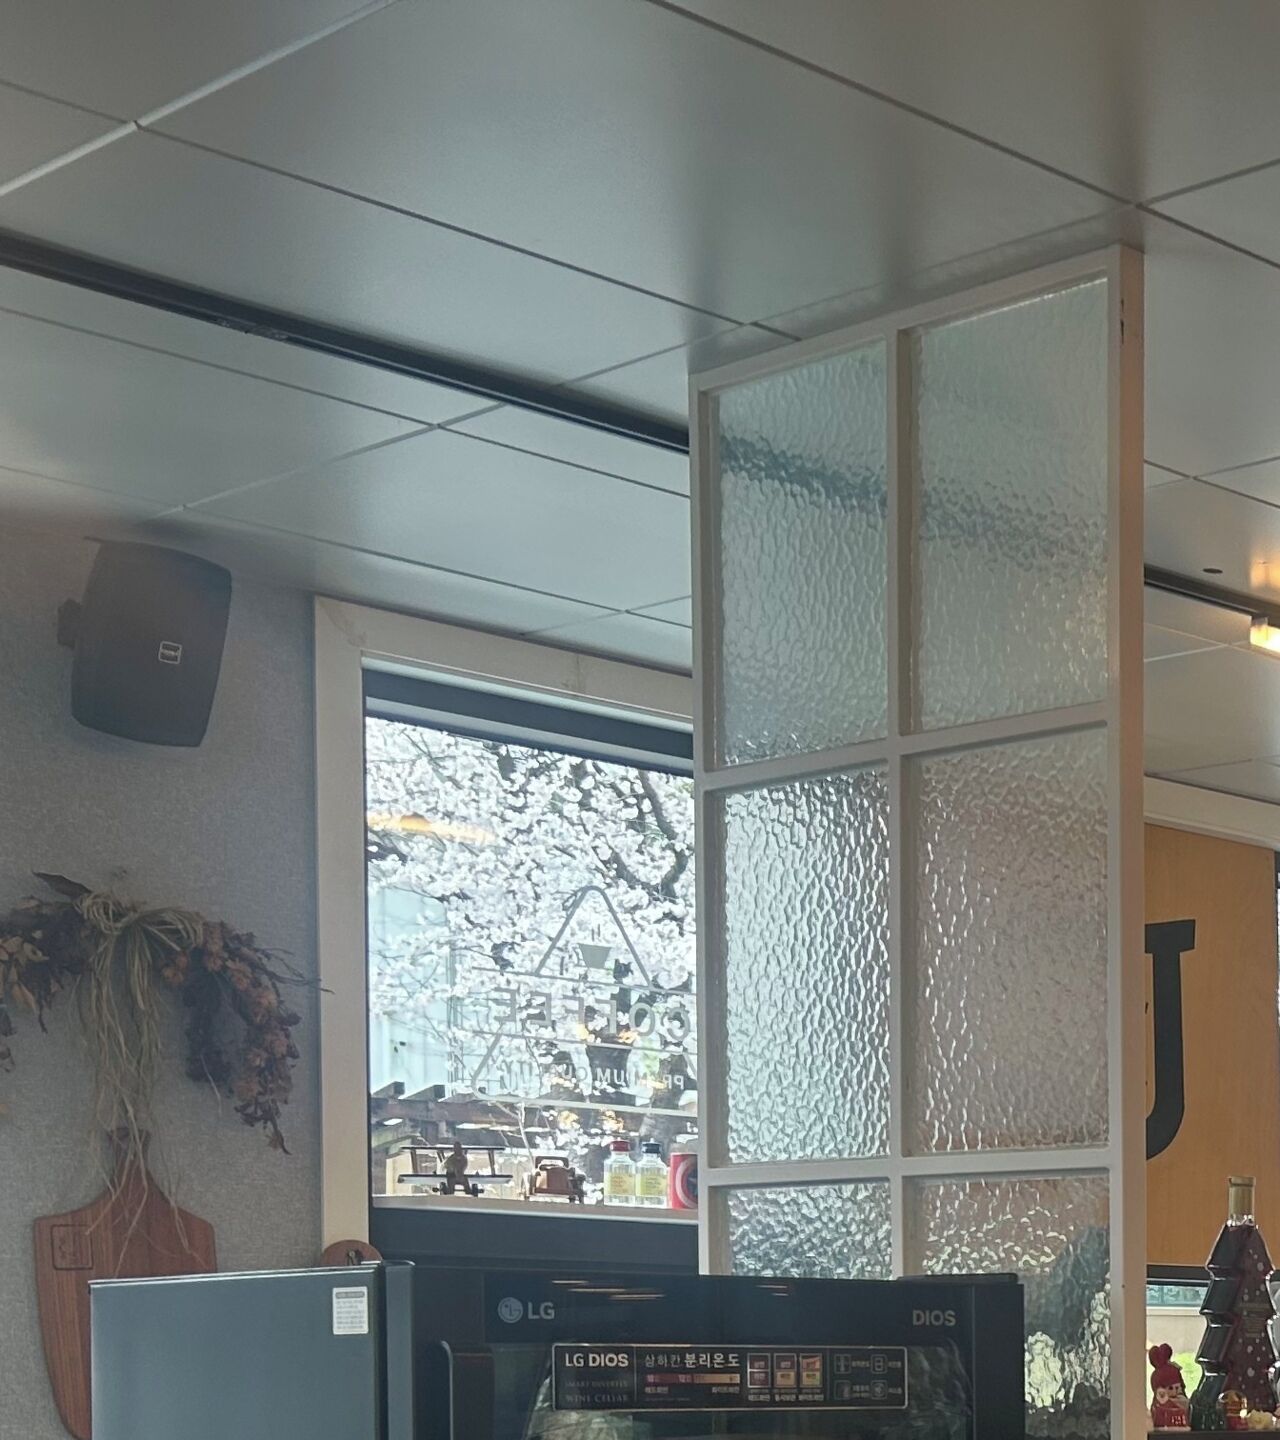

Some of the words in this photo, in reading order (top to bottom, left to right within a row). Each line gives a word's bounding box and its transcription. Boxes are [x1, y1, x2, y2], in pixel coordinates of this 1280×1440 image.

[528, 1303, 555, 1320] LG
[912, 1309, 957, 1327] DIOS
[565, 1353, 585, 1367] LG
[588, 1353, 630, 1368] DIOS
